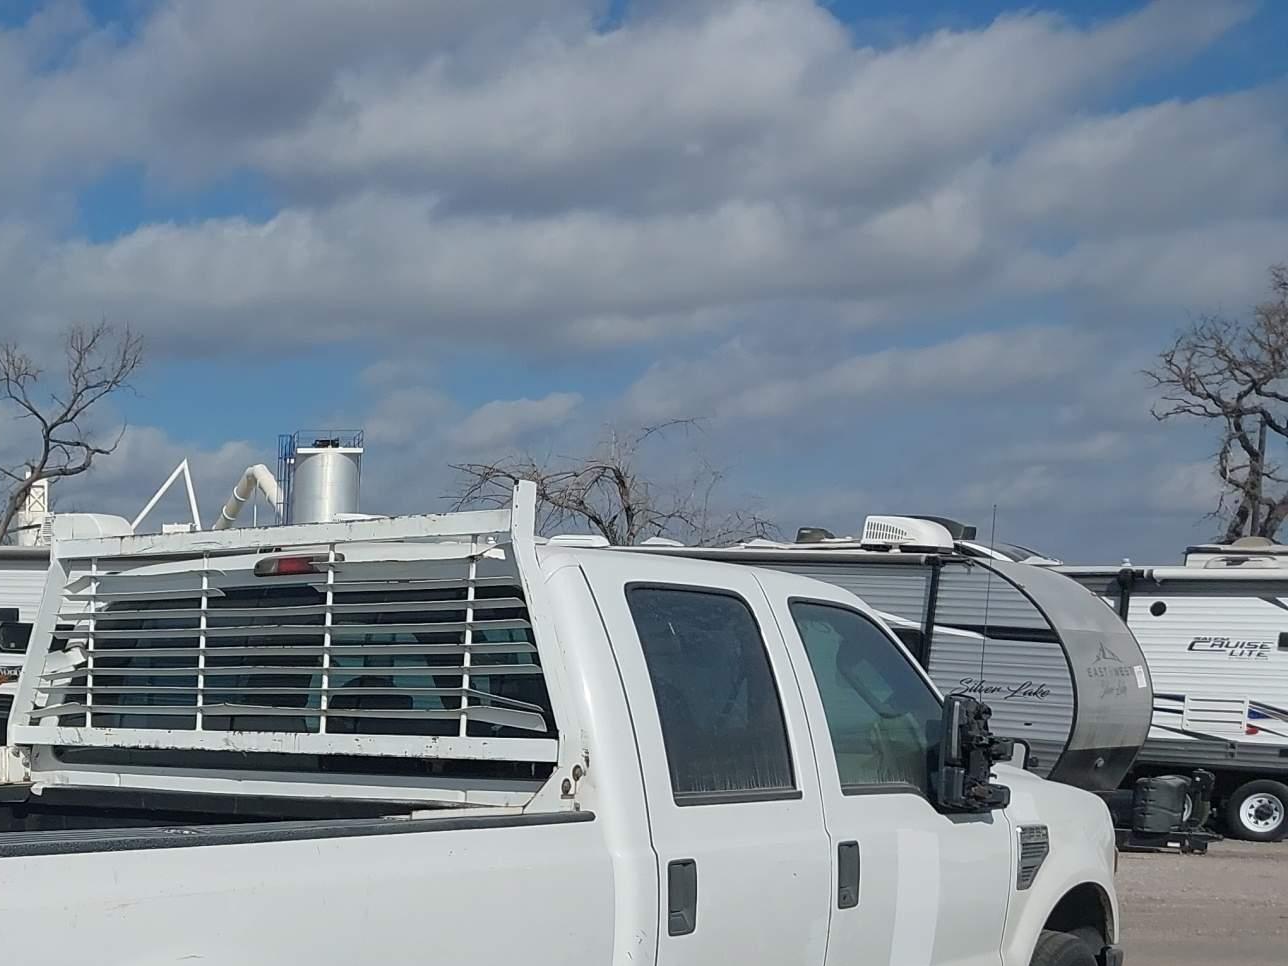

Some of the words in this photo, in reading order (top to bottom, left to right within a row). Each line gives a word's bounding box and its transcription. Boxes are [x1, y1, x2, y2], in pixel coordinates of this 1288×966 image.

[1187, 640, 1274, 652] CRUISE
[1228, 649, 1271, 658] LITE
[952, 677, 1003, 695] Silver
[1004, 680, 1051, 699] Lake
